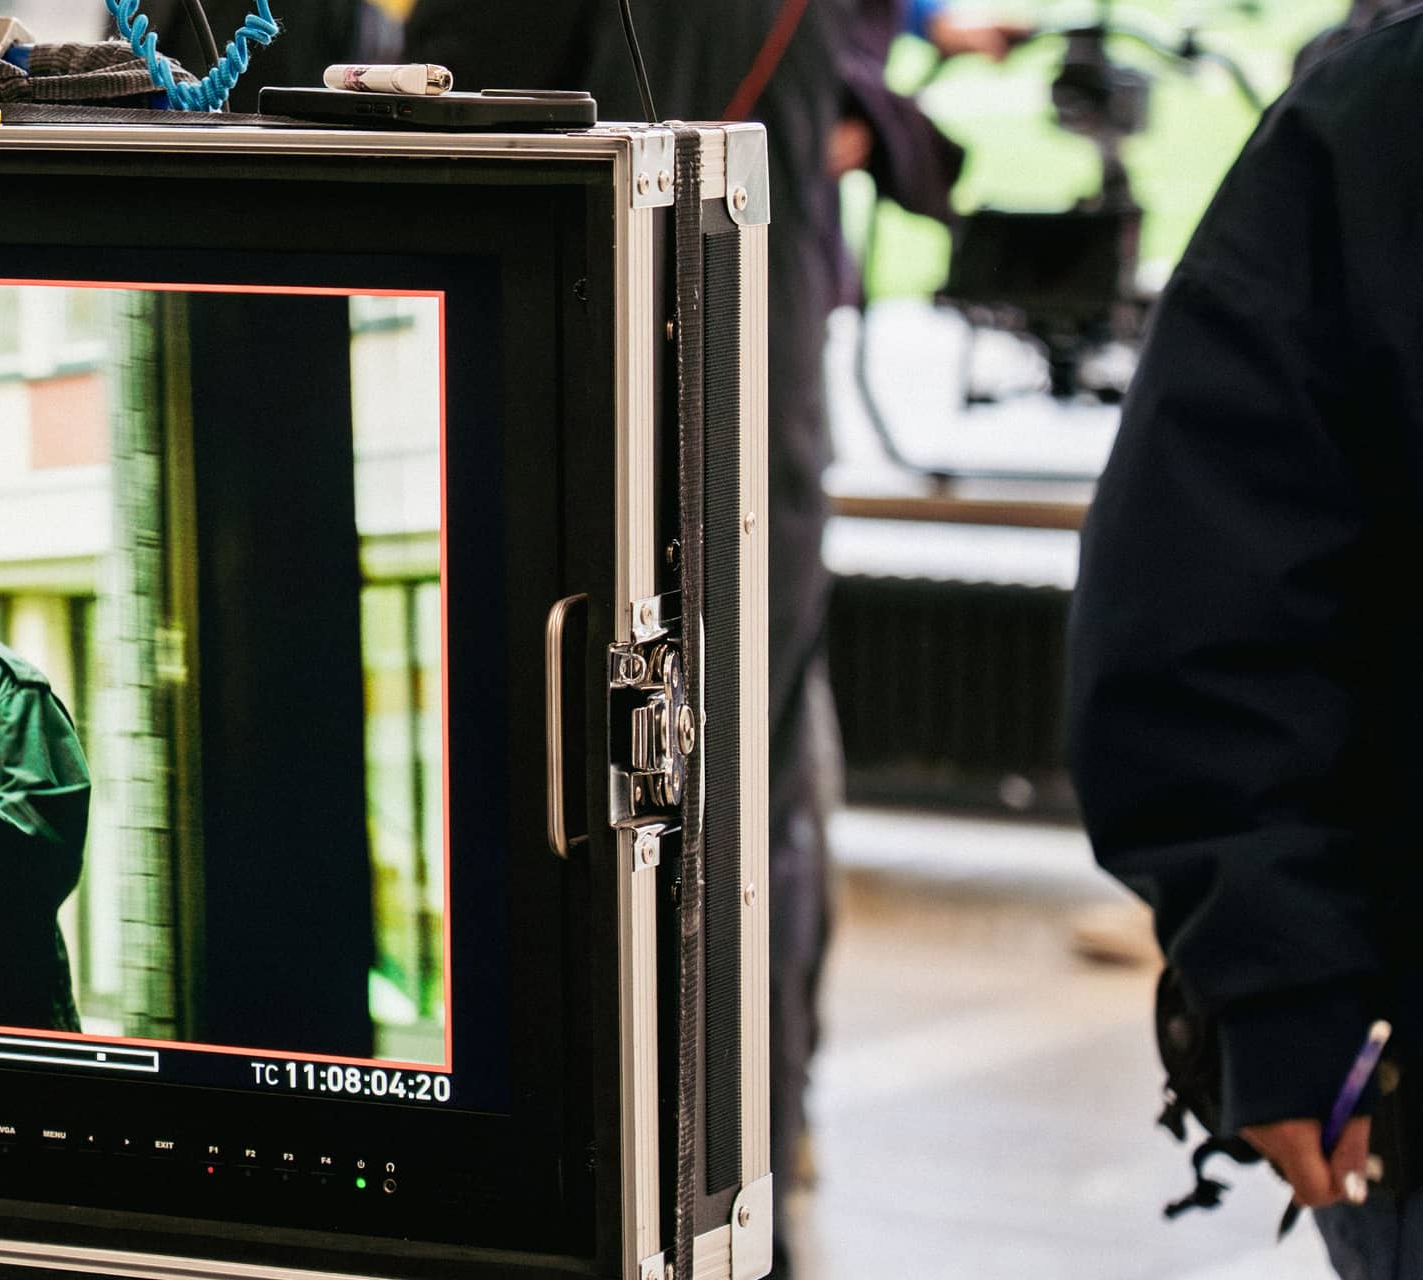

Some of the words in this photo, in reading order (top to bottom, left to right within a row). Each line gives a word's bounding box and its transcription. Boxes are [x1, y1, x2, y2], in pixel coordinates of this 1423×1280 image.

[250, 1062, 279, 1086] TC
[285, 1061, 451, 1102] 11:08:04:20
[42, 1129, 67, 1140] MENU
[154, 1140, 175, 1150] EXIT
[208, 1145, 219, 1154] F1
[245, 1149, 256, 1158] F2
[283, 1153, 294, 1161] F3
[320, 1156, 332, 1165] F4
